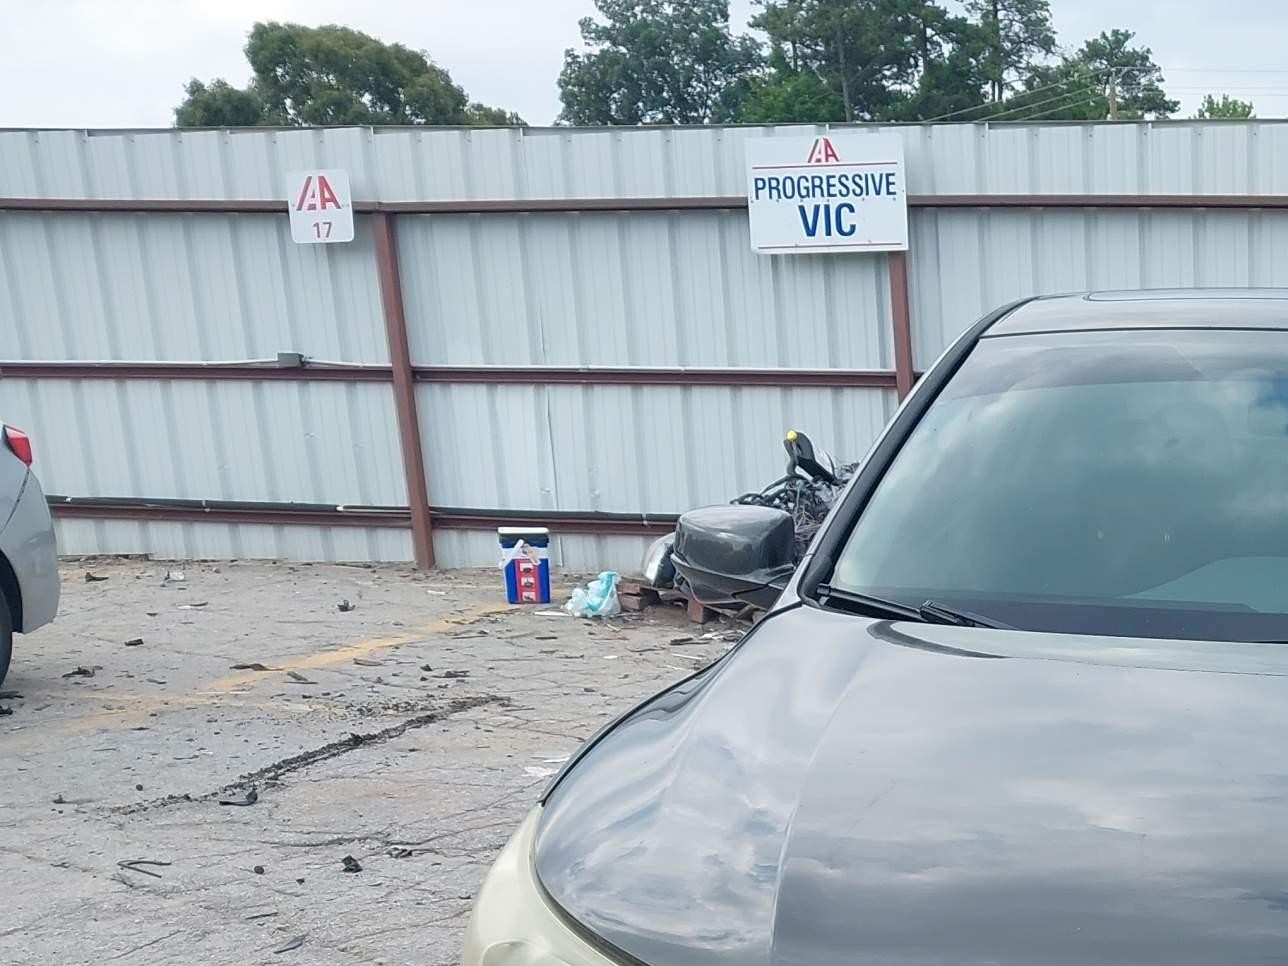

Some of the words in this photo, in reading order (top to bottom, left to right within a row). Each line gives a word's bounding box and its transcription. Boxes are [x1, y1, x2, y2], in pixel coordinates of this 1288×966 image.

[754, 173, 897, 200] PROGRESSIVE
[312, 221, 333, 239] 17
[798, 203, 856, 238] VIC
